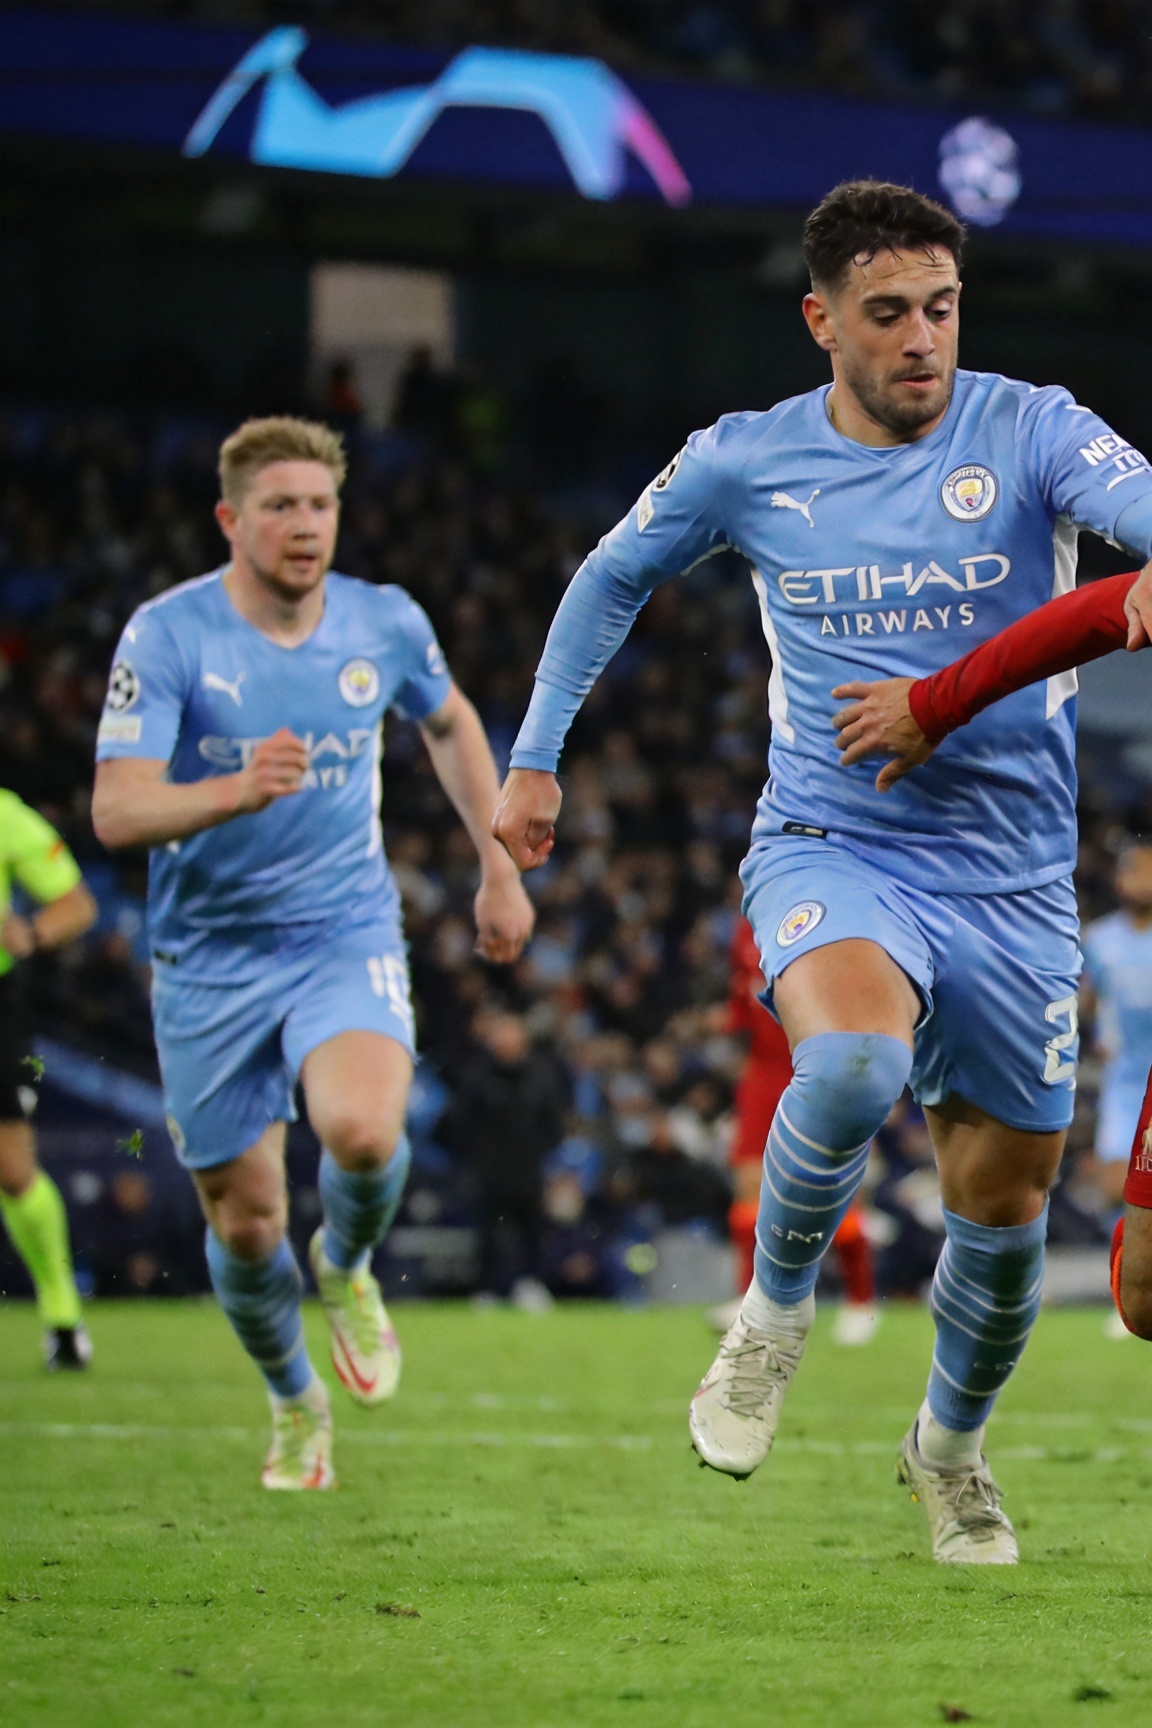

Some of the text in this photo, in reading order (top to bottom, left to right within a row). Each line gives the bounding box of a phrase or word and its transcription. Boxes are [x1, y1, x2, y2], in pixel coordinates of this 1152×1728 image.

[779, 553, 1011, 604] ETIHAD
[820, 602, 975, 637] AIRWAYS
[1044, 994, 1078, 1084] 2
